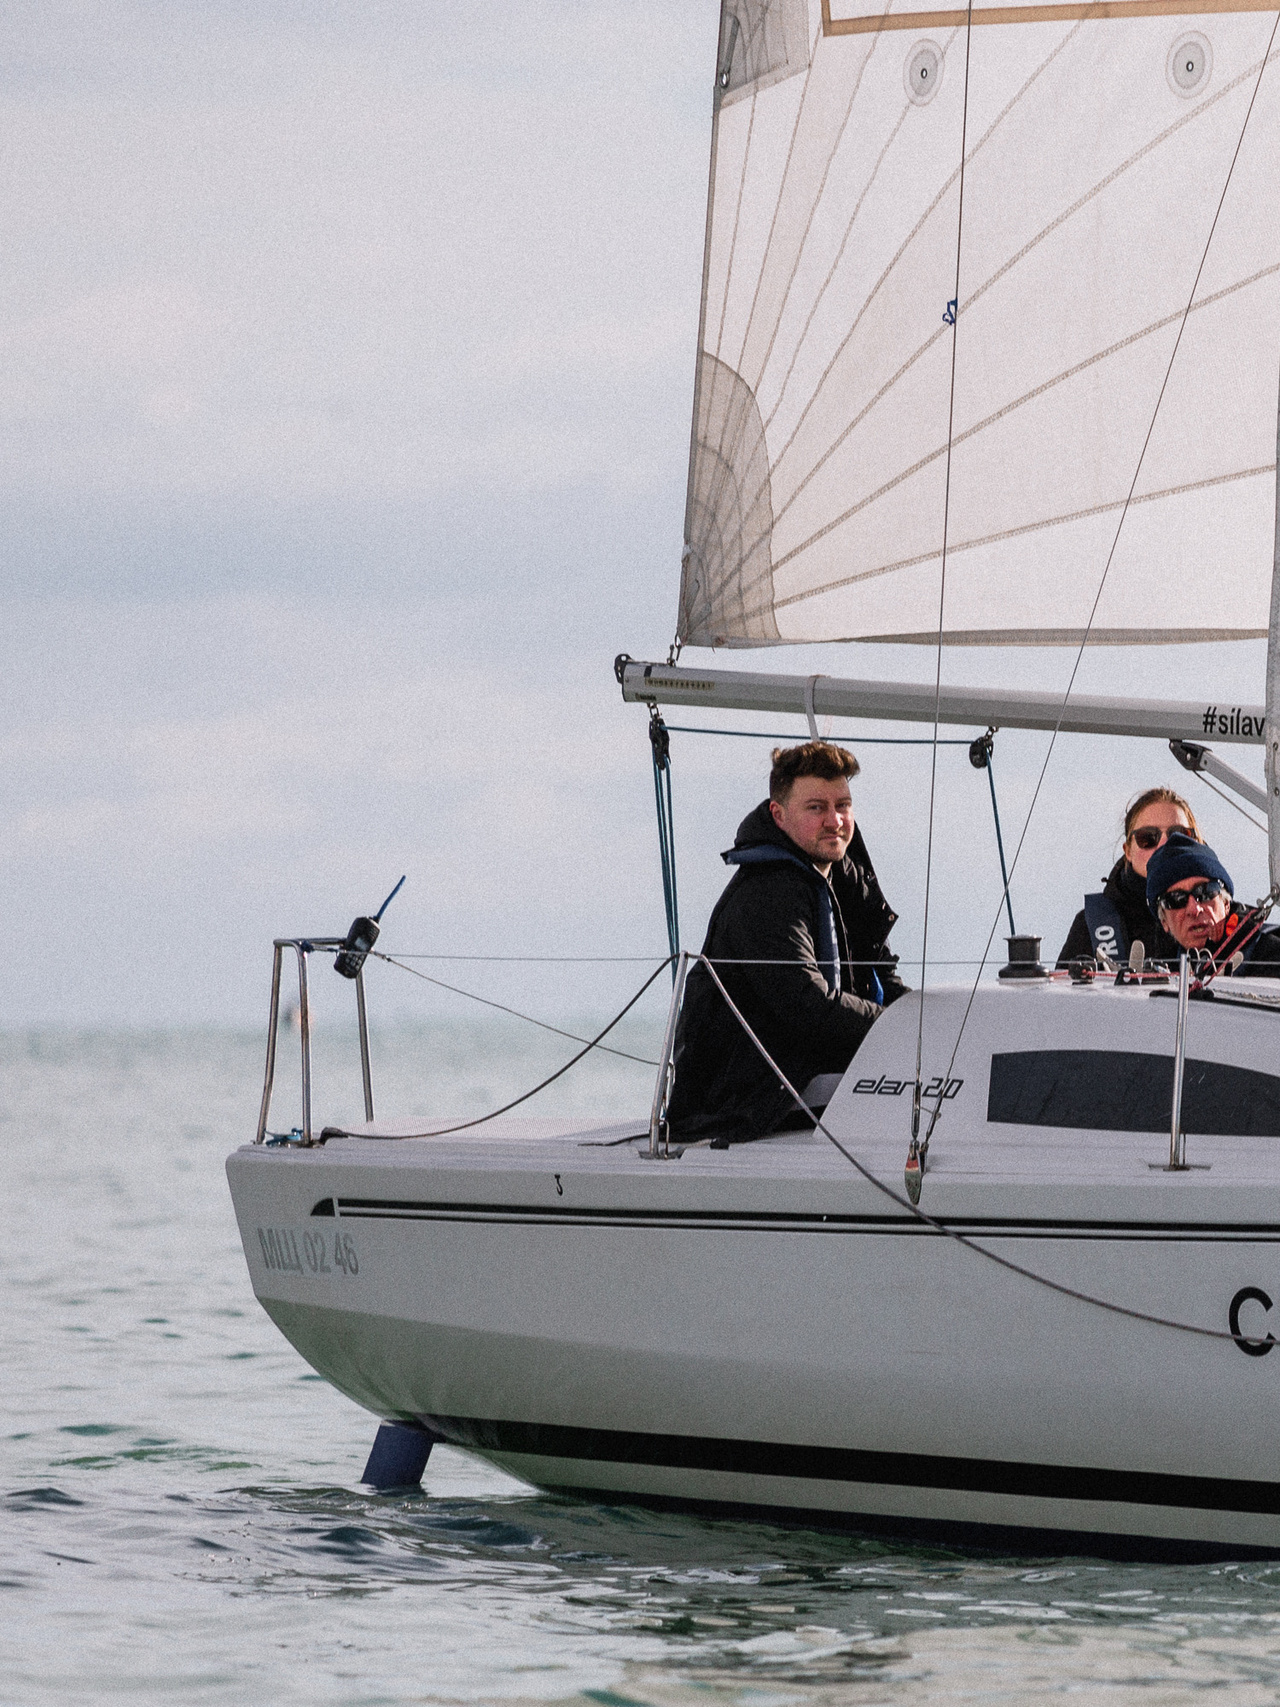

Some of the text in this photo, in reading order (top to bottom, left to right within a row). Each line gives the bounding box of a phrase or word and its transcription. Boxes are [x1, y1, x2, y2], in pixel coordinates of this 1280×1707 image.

[1202, 706, 1266, 736] #silav
[257, 1228, 359, 1275] МЩ 02 46
